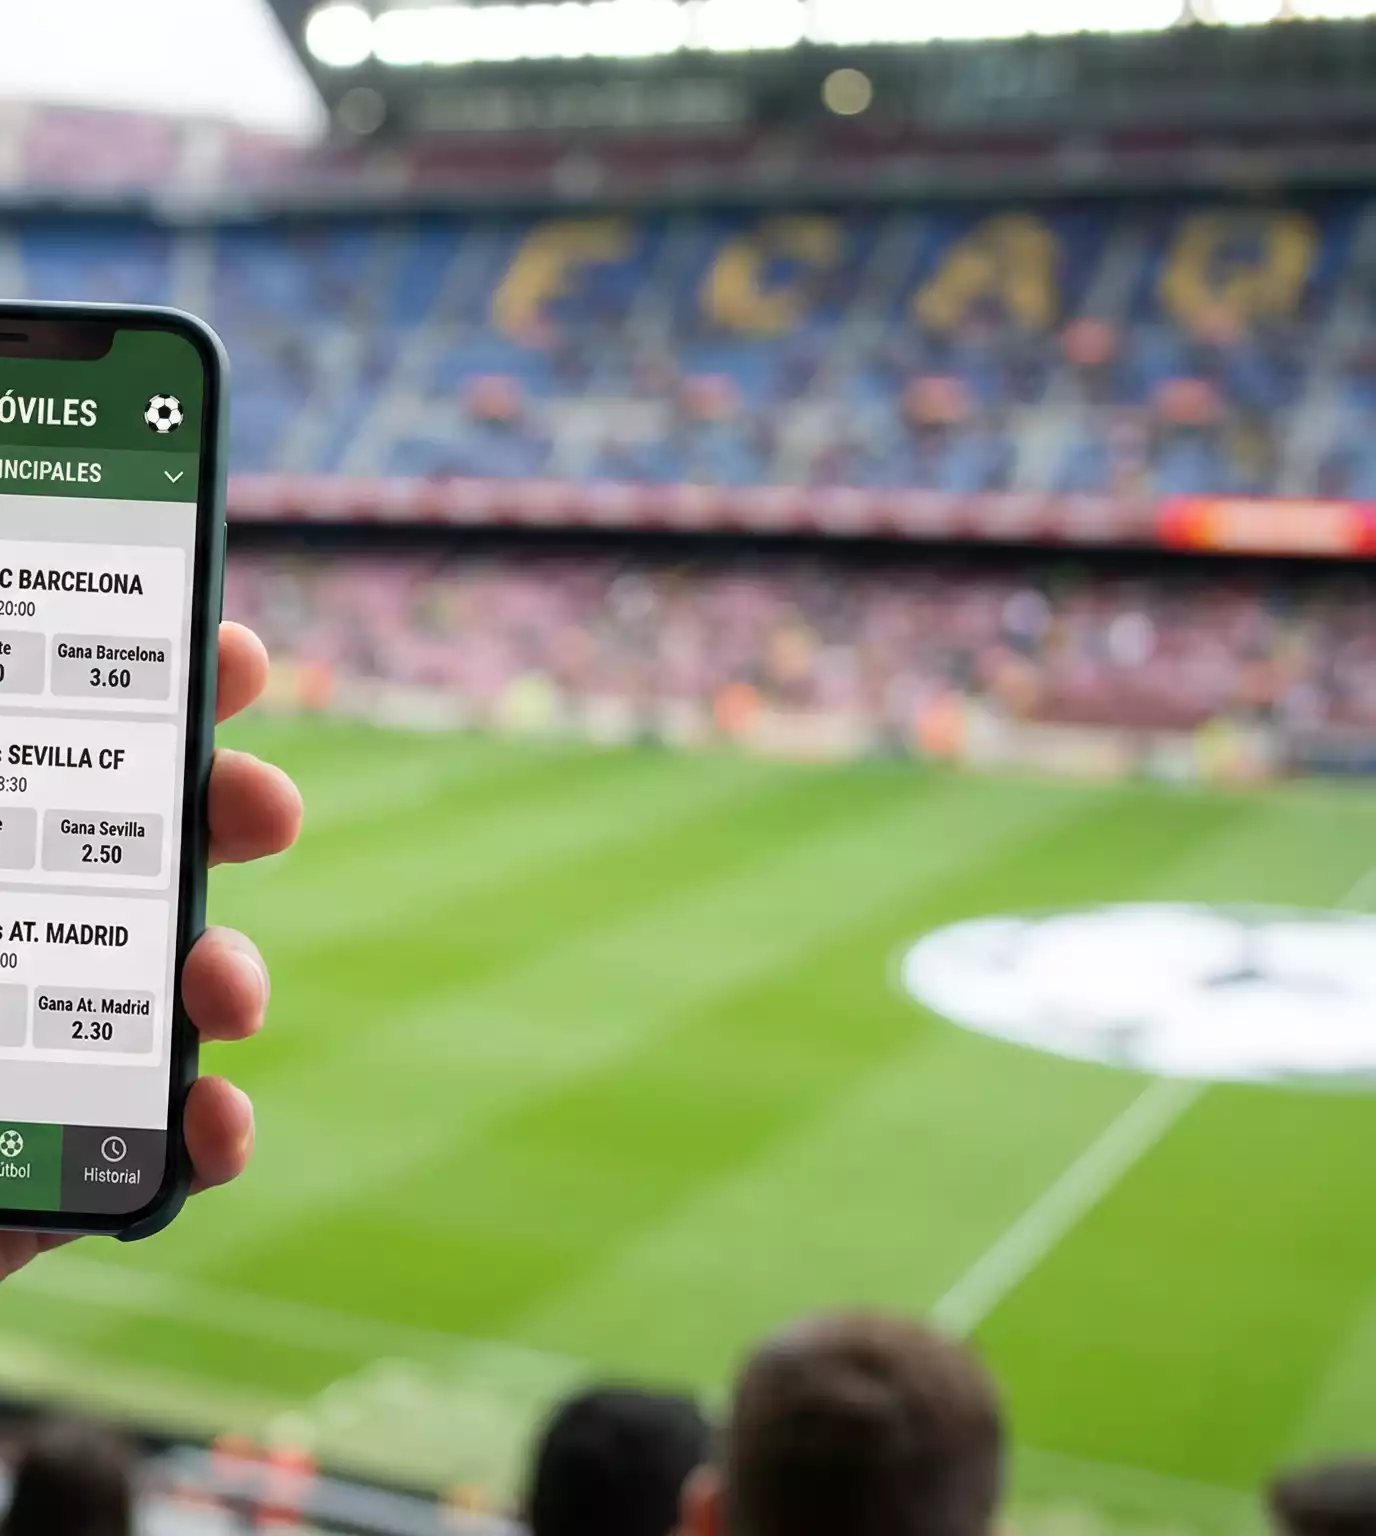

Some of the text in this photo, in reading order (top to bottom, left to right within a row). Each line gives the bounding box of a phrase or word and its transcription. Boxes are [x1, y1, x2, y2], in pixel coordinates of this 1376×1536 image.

[19, 569, 143, 595] BARCELONA
[58, 644, 164, 662] Gana Barcelona
[90, 668, 130, 687] 3.60
[8, 745, 92, 768] SEVILLA
[99, 749, 125, 769] CF
[61, 820, 144, 837] Gana Sevilla
[82, 844, 121, 863] 2.50
[9, 921, 38, 942] AT.
[46, 923, 128, 946] MADRID
[39, 996, 149, 1015] Gana At. Madrid
[72, 1021, 112, 1040] 2.30
[85, 1168, 140, 1184] Historial
